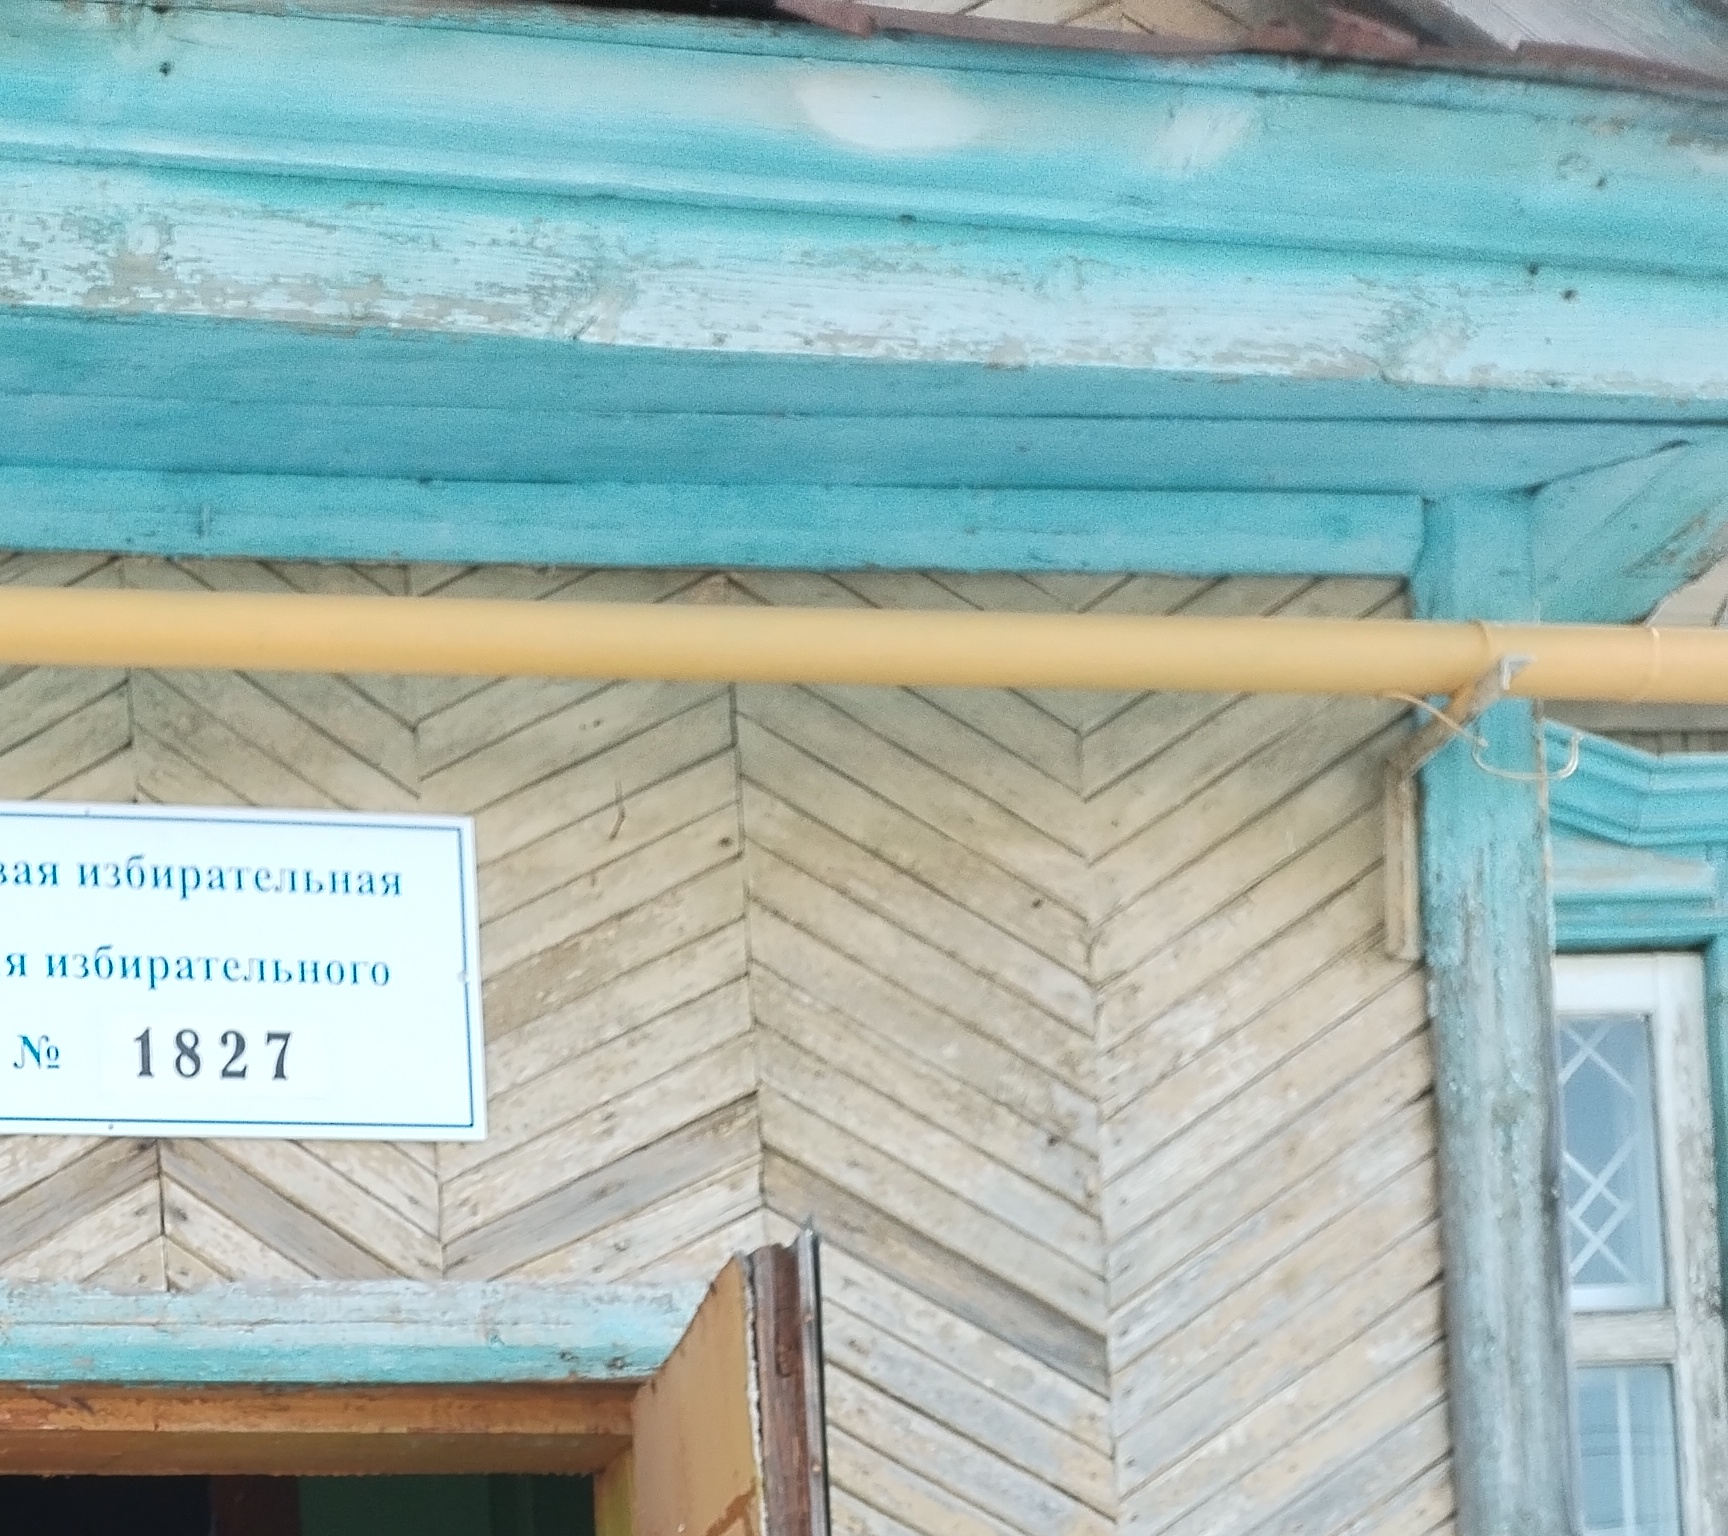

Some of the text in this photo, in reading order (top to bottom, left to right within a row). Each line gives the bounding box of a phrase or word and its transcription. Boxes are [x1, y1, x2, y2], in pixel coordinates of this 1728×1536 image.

[78, 853, 402, 900] избирательная
[46, 946, 391, 991] избирательного
[13, 1034, 61, 1071] №
[134, 1029, 293, 1081] 1827
